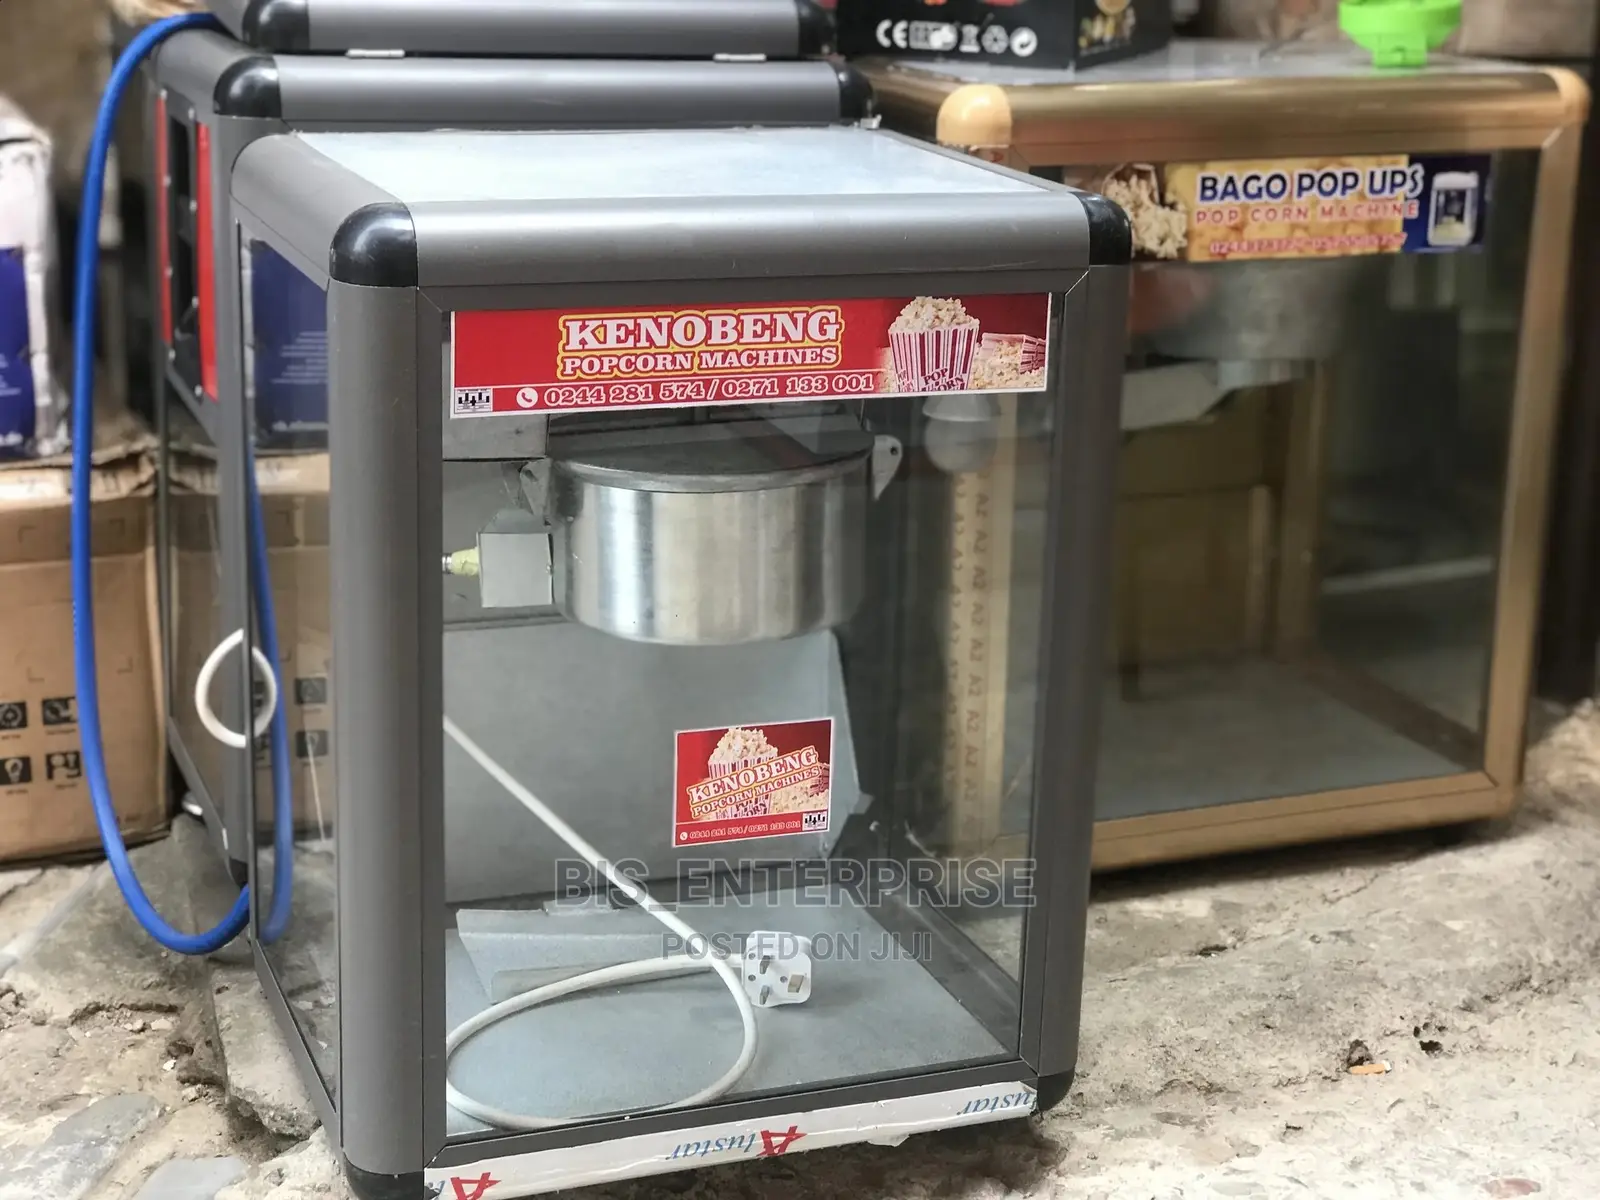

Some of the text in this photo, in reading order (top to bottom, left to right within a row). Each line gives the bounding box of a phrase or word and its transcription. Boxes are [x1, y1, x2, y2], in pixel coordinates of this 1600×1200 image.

[1199, 167, 1420, 201] BAGO POP UPS
[1196, 202, 1418, 224] POP CORN MACHINE
[563, 310, 841, 351] KENOBENG
[563, 346, 838, 376] POPCORN MACHINES
[545, 386, 604, 406] 0244
[609, 383, 653, 404] 281
[786, 376, 829, 395] 133
[833, 374, 874, 393] 001
[688, 746, 818, 805] KENOBENG
[693, 788, 753, 818] POPCORN
[755, 766, 820, 796] MACHINES
